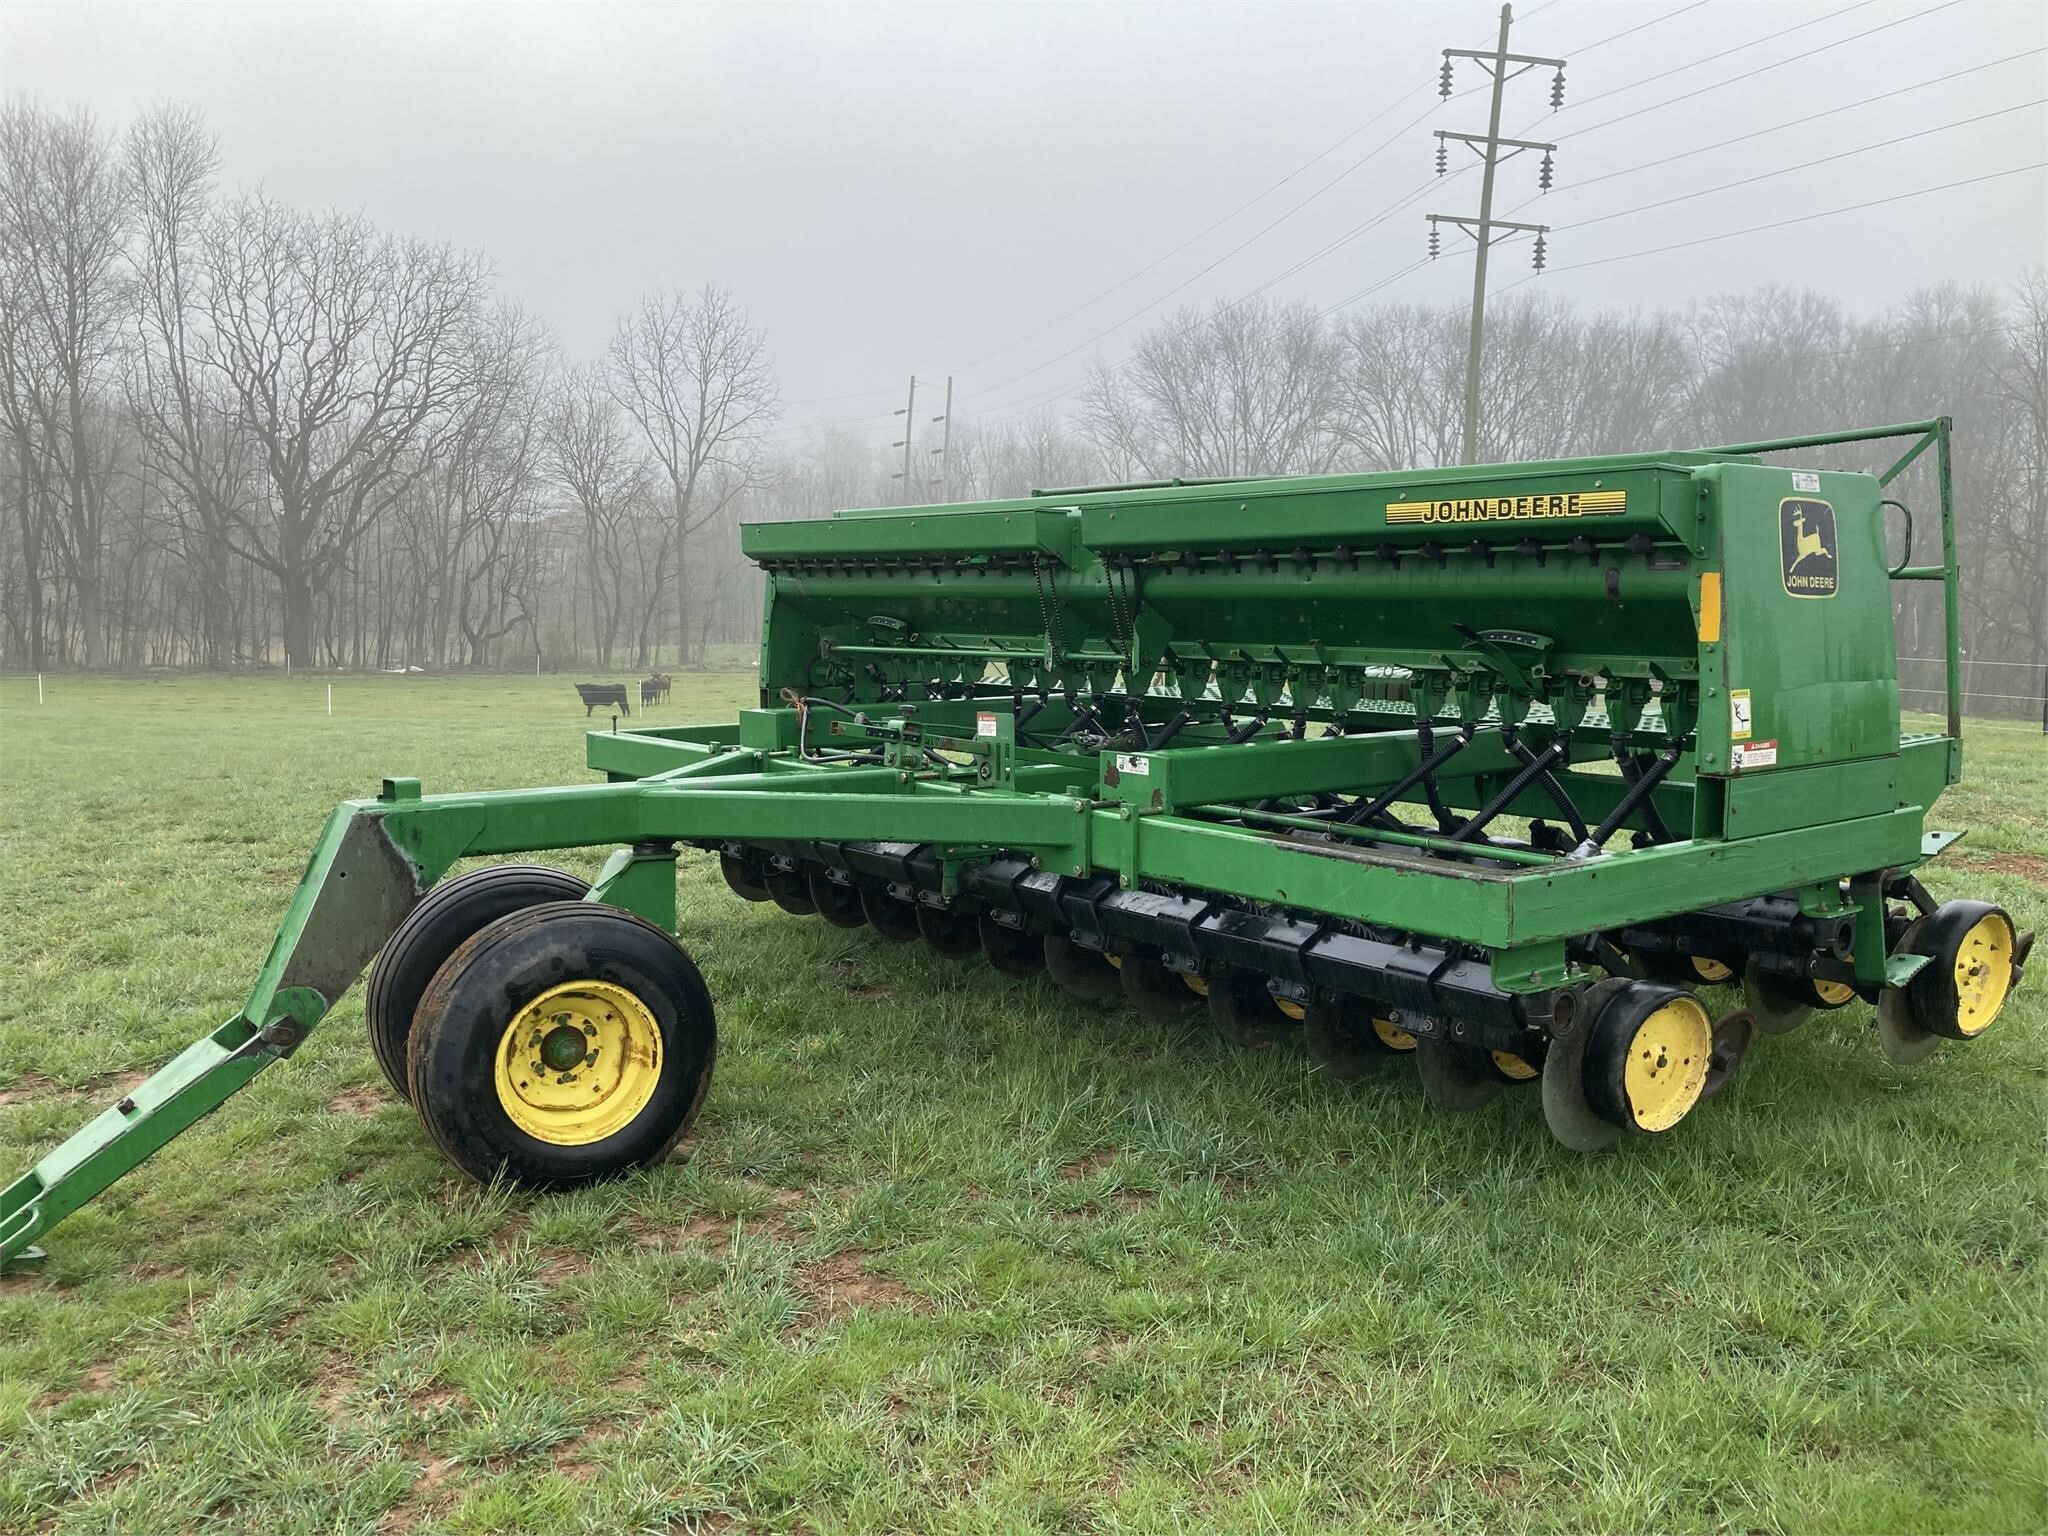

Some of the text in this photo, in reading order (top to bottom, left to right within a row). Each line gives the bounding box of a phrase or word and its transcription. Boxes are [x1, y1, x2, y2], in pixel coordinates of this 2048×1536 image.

[1422, 495, 1581, 523] JOHN DEERE
[1787, 575, 1834, 588] JOHN DEERE
